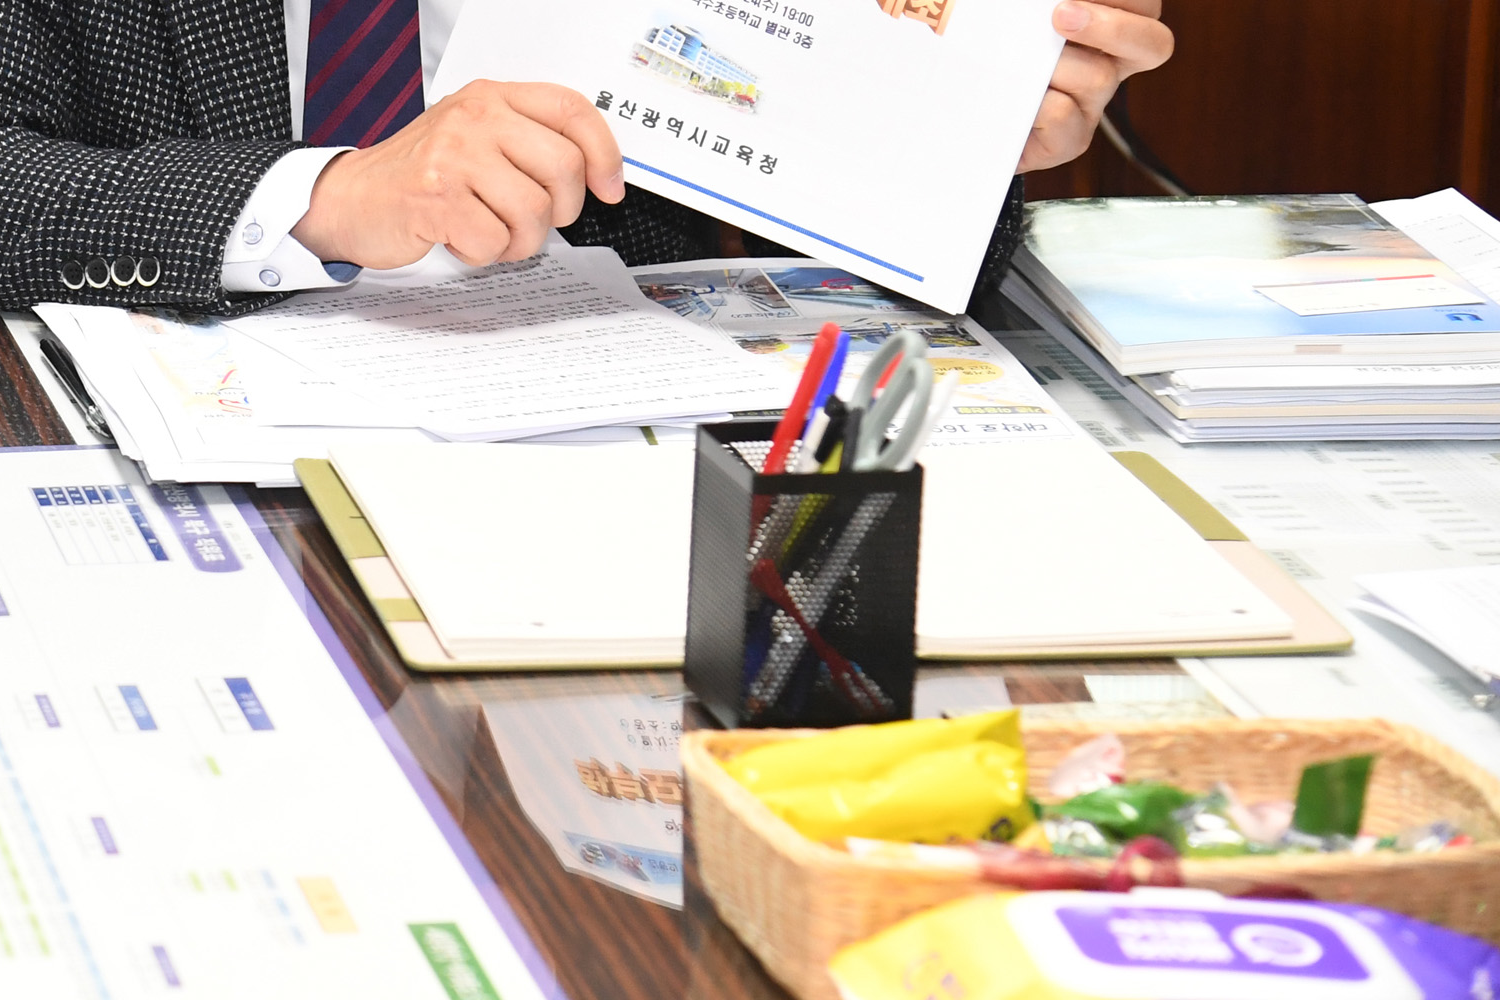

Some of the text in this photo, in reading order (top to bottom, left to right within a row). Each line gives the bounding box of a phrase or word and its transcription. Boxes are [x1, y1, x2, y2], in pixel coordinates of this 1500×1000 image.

[782, 5, 814, 27] 19:00
[765, 19, 791, 41] 별관
[793, 31, 814, 50] 3층
